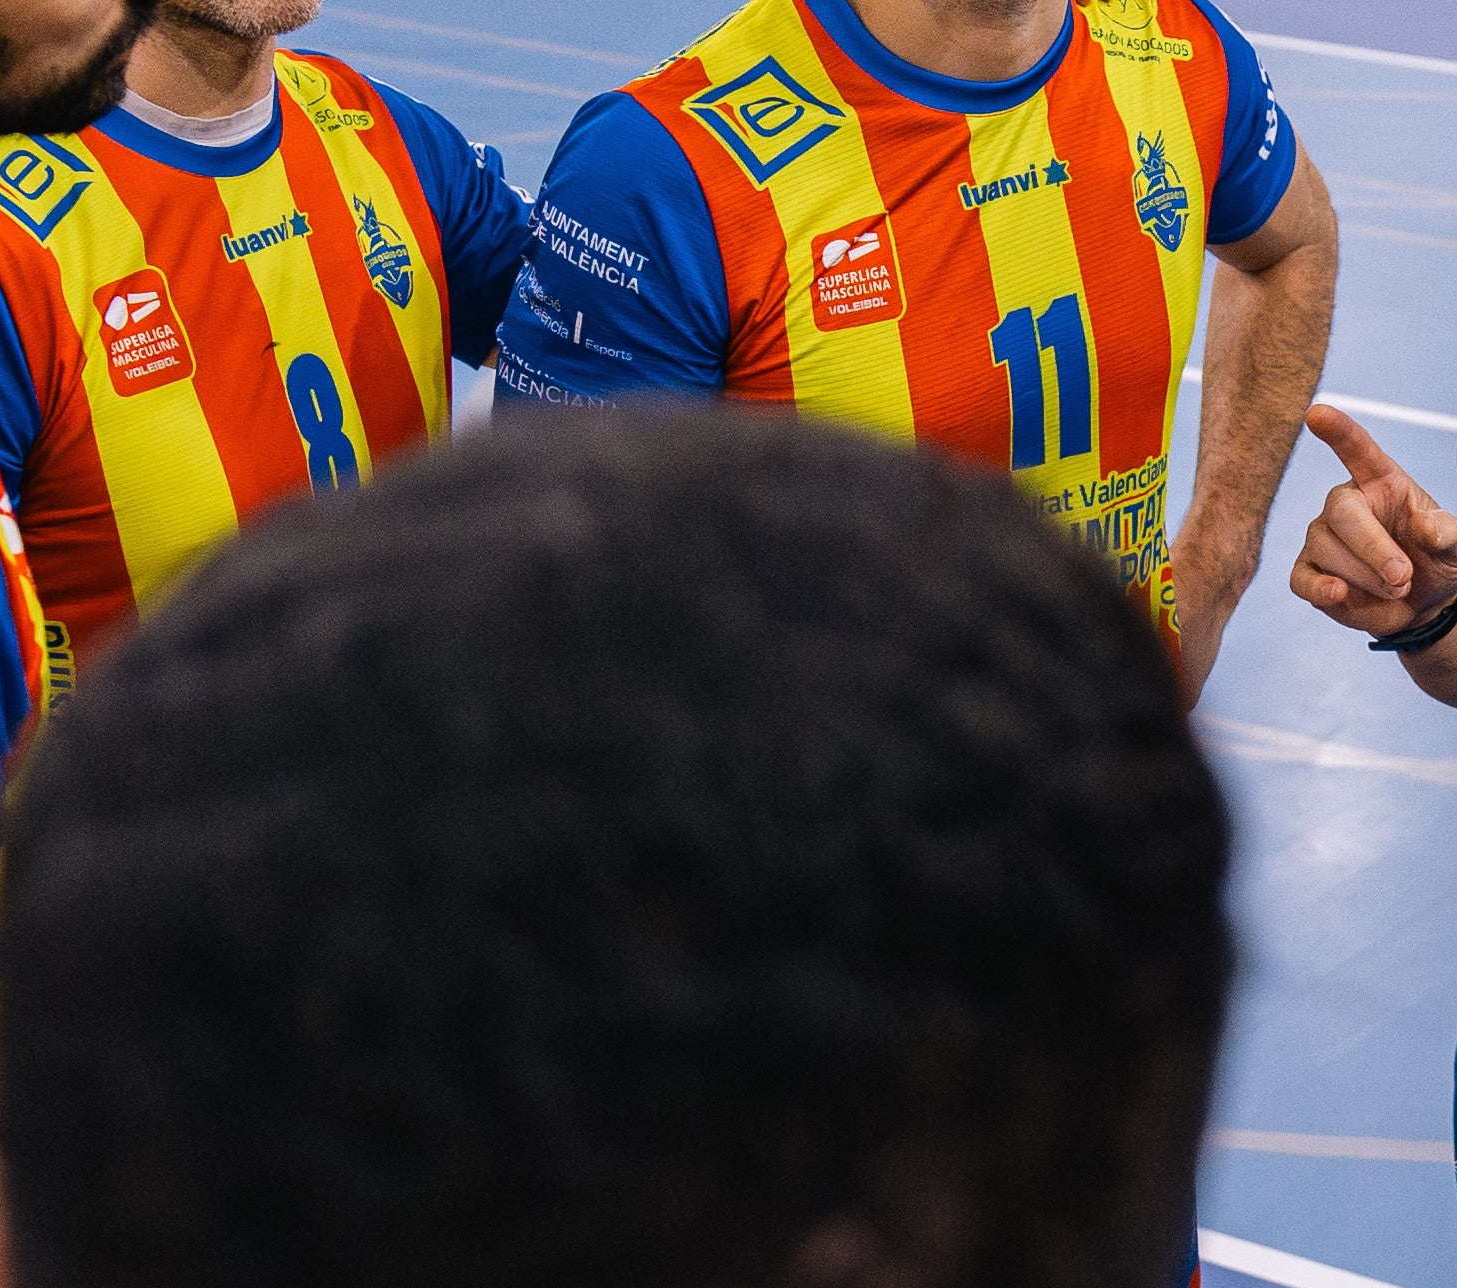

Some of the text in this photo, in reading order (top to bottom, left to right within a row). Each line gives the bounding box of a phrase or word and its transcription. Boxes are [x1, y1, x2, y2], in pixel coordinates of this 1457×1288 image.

[962, 164, 1038, 208] luanvi
[223, 215, 289, 260] luanvi
[550, 236, 640, 295] VALÈNCIA
[817, 265, 890, 291] SUPERLIGA
[820, 278, 892, 302] MASCULINA
[828, 297, 888, 316] VOLEIBOL
[111, 324, 175, 354] SUPERLIGA
[113, 337, 179, 367] MASCULINA
[586, 338, 633, 361] Esports
[124, 356, 180, 379] VOLEIBOL
[990, 293, 1092, 472] 11
[287, 353, 360, 500] 8
